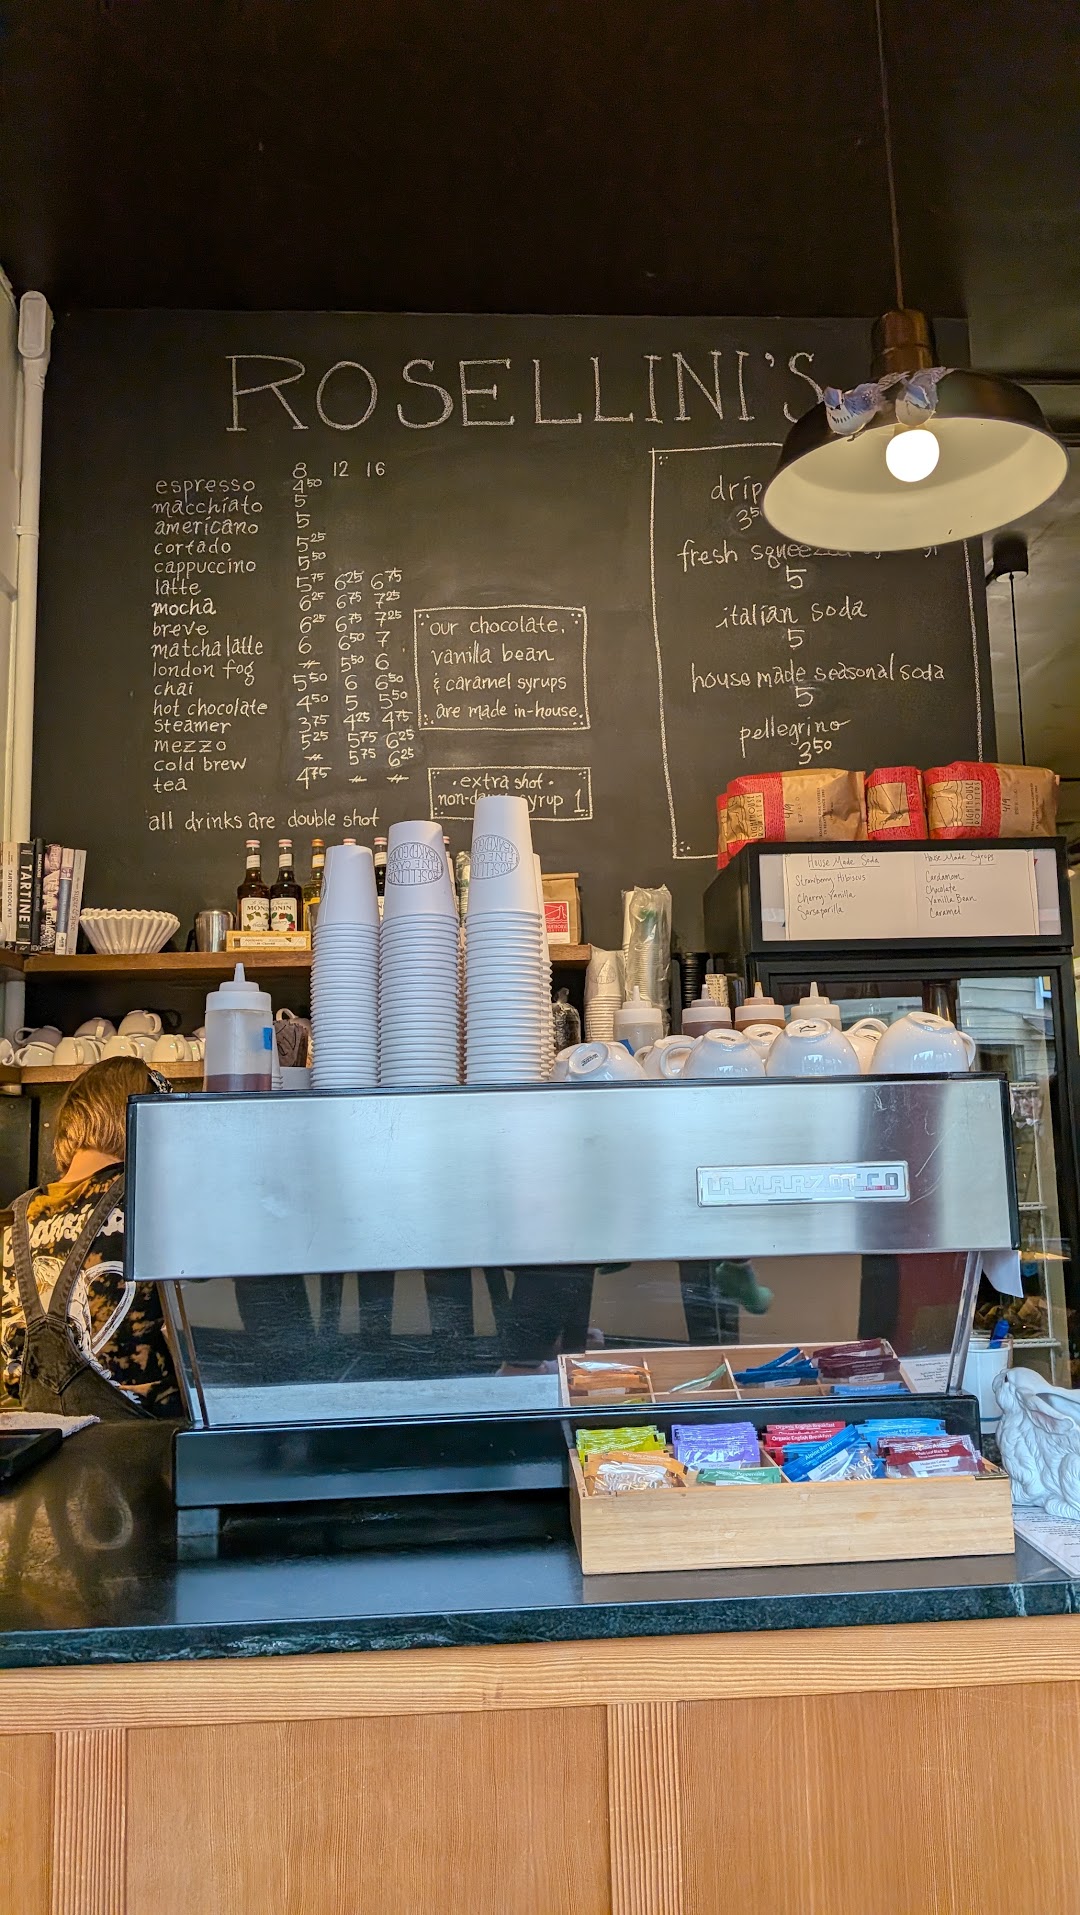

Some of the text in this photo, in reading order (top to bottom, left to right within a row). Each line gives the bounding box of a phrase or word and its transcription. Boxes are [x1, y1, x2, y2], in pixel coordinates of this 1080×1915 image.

[224, 350, 825, 432] ROSELLINI'S
[292, 460, 386, 479] 8 12 16
[155, 479, 255, 502] espresso
[711, 475, 763, 505] drip
[151, 494, 308, 516] macchiato 5
[154, 513, 310, 535] americano 5
[154, 537, 231, 555] cortado
[677, 538, 738, 572] fresh
[154, 558, 257, 580] cappuccino
[785, 565, 807, 589] 5
[155, 578, 202, 595] latte
[151, 598, 217, 615] mocha
[715, 596, 868, 628] italian soda
[153, 620, 209, 637] breve
[429, 622, 459, 636] our
[787, 628, 805, 648] 5
[151, 638, 222, 657] matcha
[227, 635, 263, 656] latte
[298, 636, 312, 654] 6
[375, 631, 391, 647] 7
[430, 640, 555, 665] vanilla bean
[153, 662, 215, 678] london
[222, 659, 254, 686] fog
[375, 653, 390, 670] 6
[691, 652, 945, 693] house made seasonal soda
[153, 681, 194, 696] chai
[344, 674, 358, 690] 6
[445, 672, 511, 692] caramel
[517, 676, 567, 694] syrups
[153, 699, 180, 716] hot
[187, 698, 268, 716] chocolate
[345, 694, 358, 711] 5
[794, 685, 813, 707] 5
[436, 699, 583, 720] are made in-house.
[154, 739, 227, 753] mezzo
[739, 714, 851, 758] pellegrino
[153, 756, 194, 772] cold
[203, 757, 247, 771] brew
[153, 776, 188, 793] tea
[459, 772, 544, 789] extra shot
[573, 788, 586, 813] 1
[148, 807, 380, 831] all drinks are double shot
[807, 853, 880, 869] House Made Soda
[943, 853, 967, 861] Made
[18, 864, 33, 922] TARTINE
[925, 883, 957, 895] Chocolate
[925, 893, 977, 905] Vanilla Bean
[929, 905, 962, 918] Caramel
